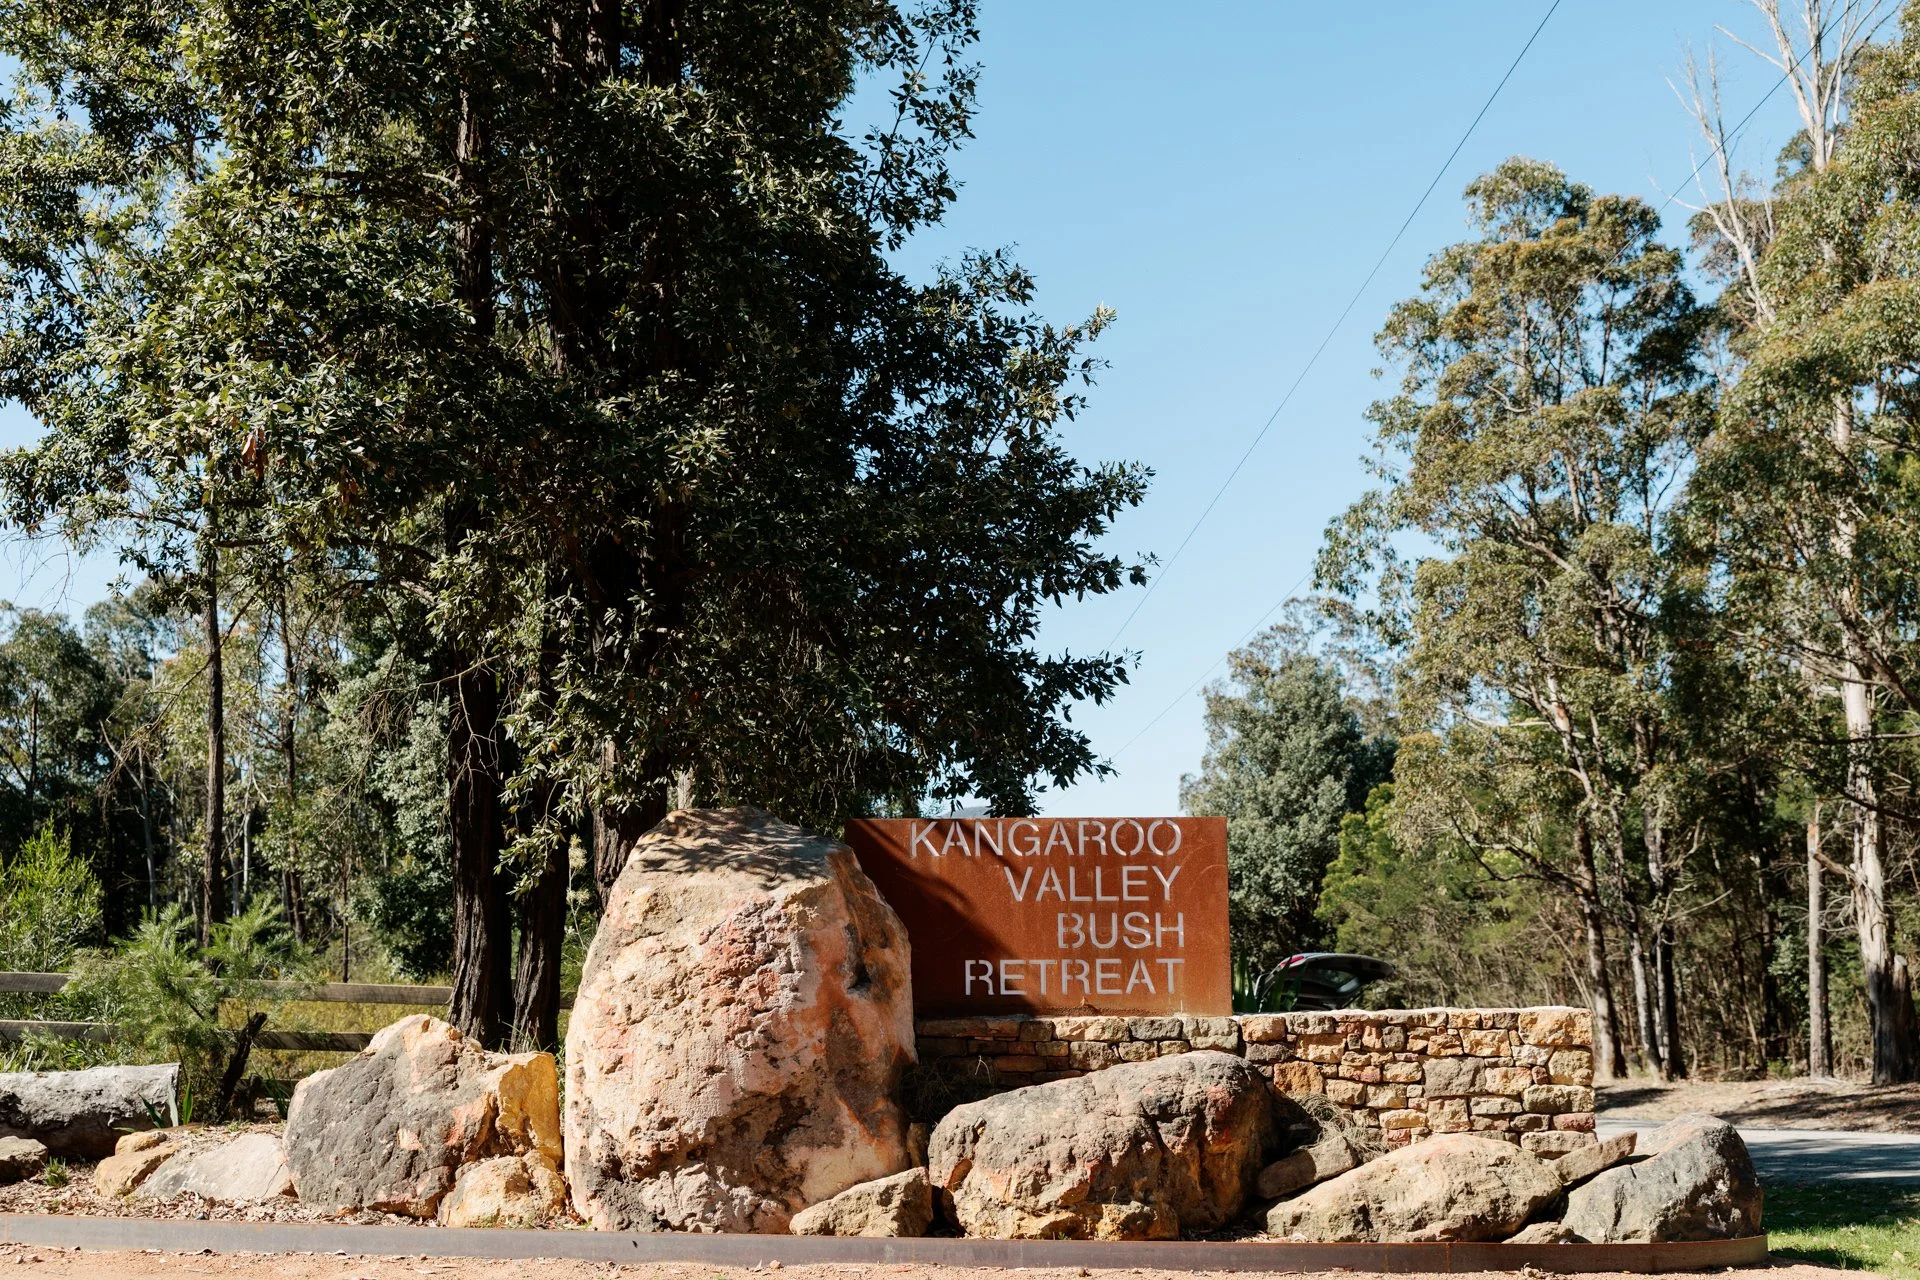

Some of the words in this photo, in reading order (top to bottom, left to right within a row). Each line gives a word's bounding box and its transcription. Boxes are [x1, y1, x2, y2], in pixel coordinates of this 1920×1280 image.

[910, 819, 1182, 857] KANGAROO
[1003, 865, 1182, 902] VALLEY
[1057, 911, 1185, 949] BUSH
[965, 958, 1185, 996] RETREAT
